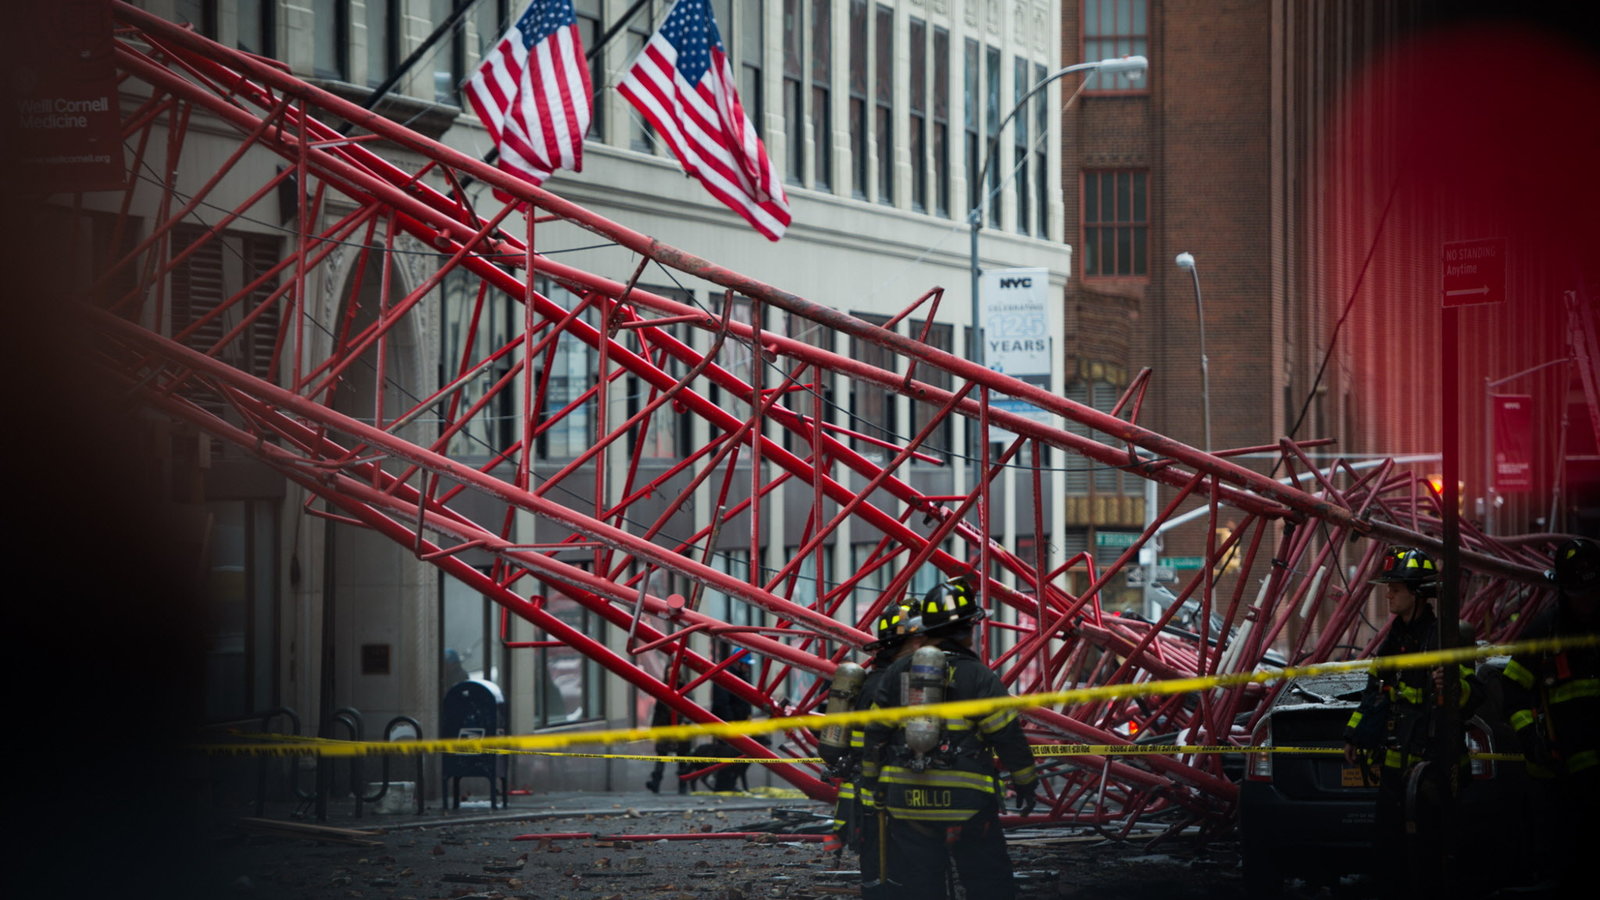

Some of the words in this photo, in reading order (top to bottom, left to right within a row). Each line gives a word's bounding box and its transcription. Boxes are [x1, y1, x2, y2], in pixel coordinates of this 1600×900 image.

[18, 98, 52, 113] Weill
[54, 97, 109, 112] Cornell
[20, 113, 88, 128] Medicine
[1446, 249, 1457, 262] NO
[1459, 247, 1496, 260] STANDING
[1447, 264, 1478, 278] Anytime
[1000, 277, 1032, 288] NYC
[988, 312, 1046, 338] 125
[990, 340, 1045, 352] YEARS
[904, 790, 951, 807] GRILLO
